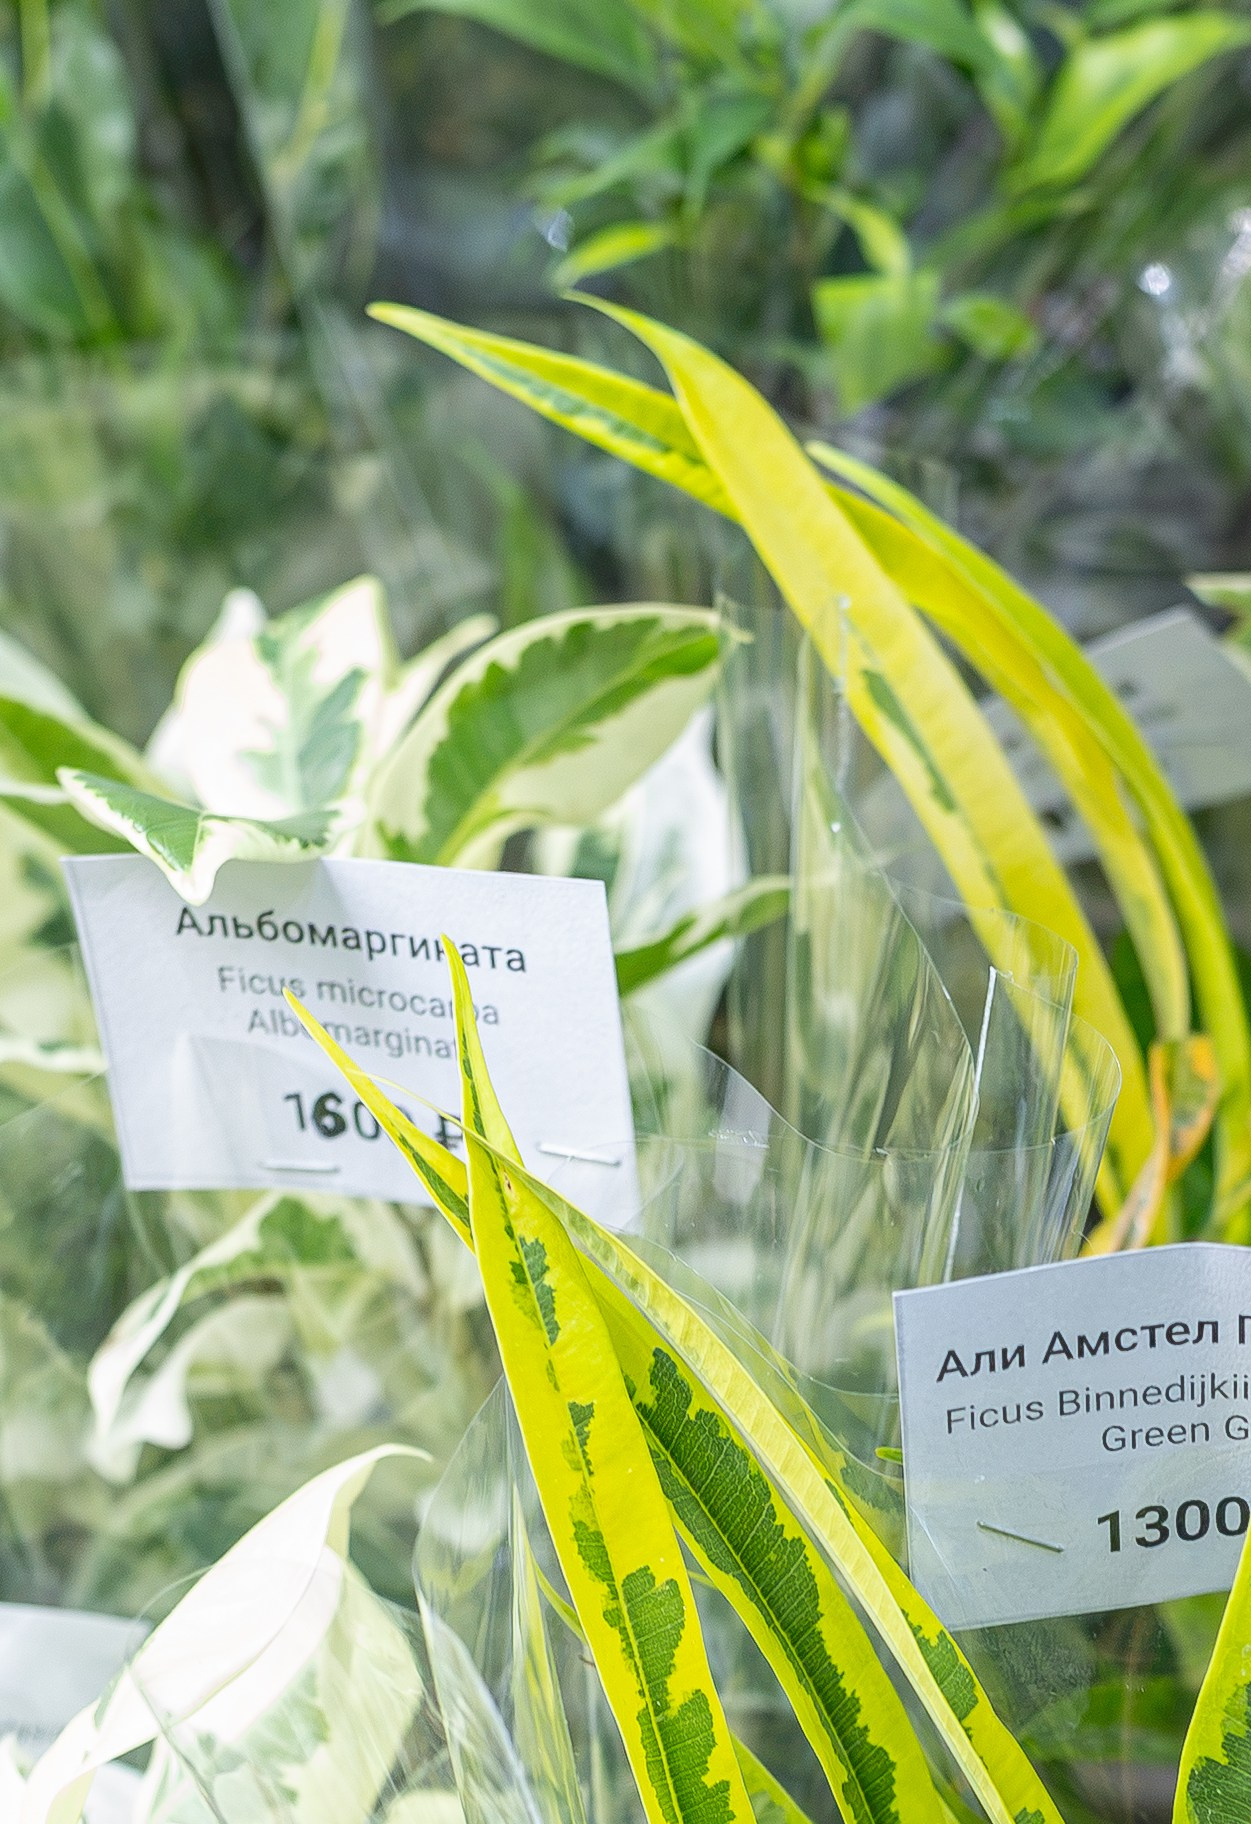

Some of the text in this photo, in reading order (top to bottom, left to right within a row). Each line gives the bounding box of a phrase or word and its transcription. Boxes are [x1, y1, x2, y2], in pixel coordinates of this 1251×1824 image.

[217, 966, 500, 1026] Ficus microcara
[936, 1344, 1025, 1383] Али
[1042, 1320, 1219, 1365] Амстел
[946, 1400, 1044, 1434] Ficus
[1058, 1372, 1249, 1417] Binnedijkii
[1102, 1421, 1210, 1452] Green
[1097, 1496, 1251, 1553] 1300
